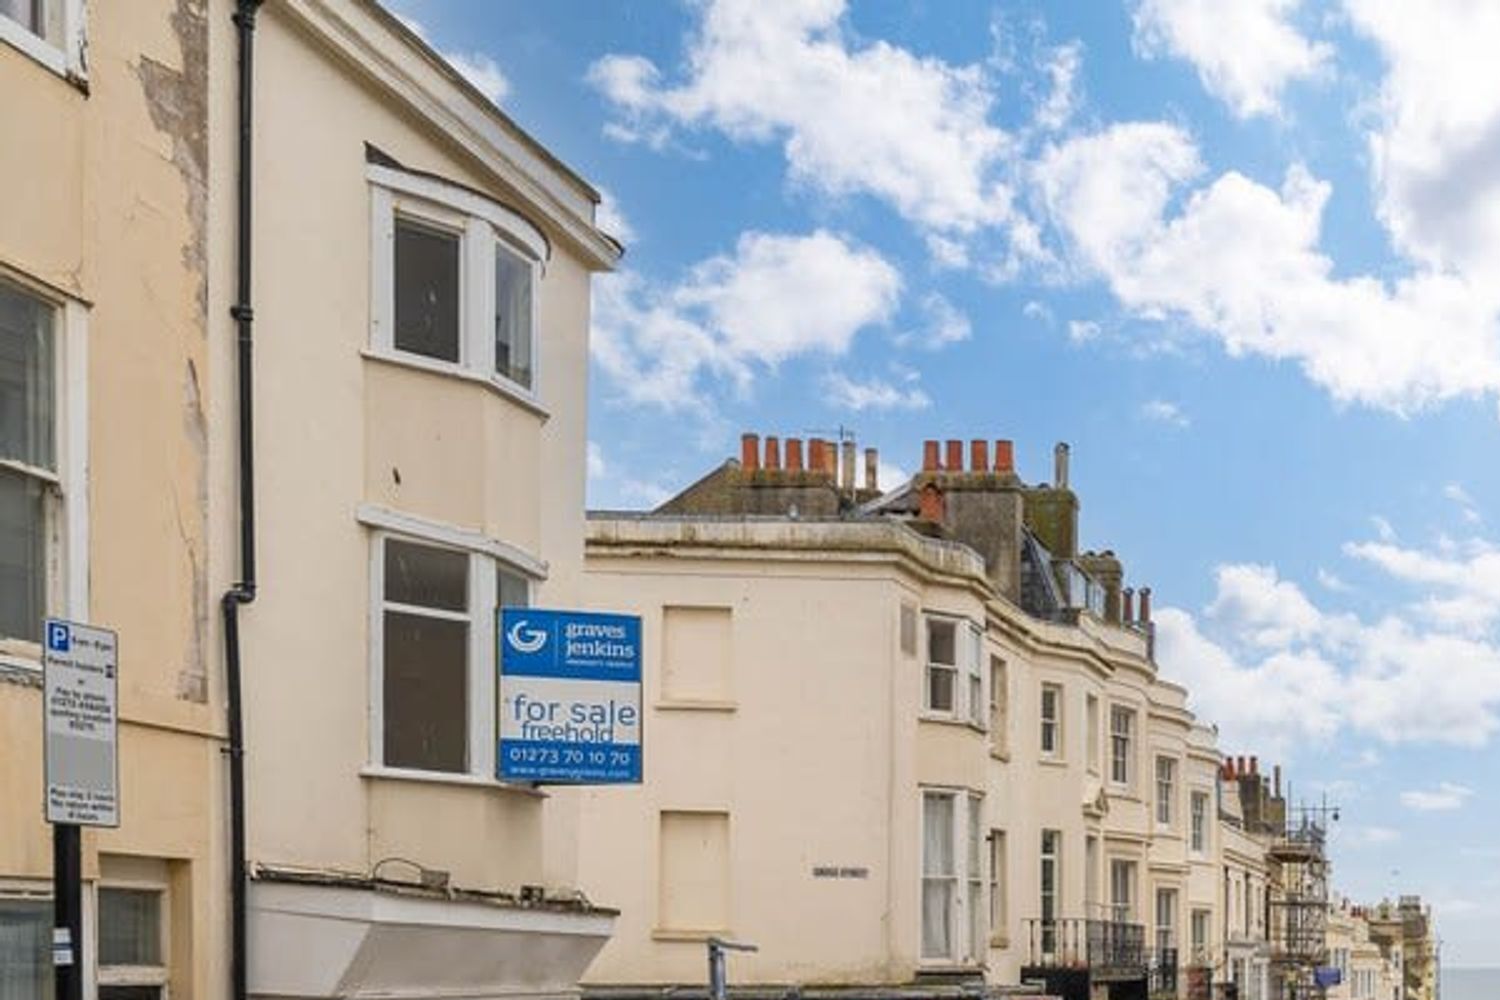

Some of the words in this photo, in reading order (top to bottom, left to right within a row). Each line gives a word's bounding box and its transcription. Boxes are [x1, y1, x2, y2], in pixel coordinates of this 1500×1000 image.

[565, 622, 625, 639] graves
[565, 640, 635, 658] jenkins
[514, 693, 560, 721] for
[570, 700, 637, 726] sale
[521, 720, 614, 742] freehold
[510, 747, 559, 764] 01273
[562, 750, 584, 765] 70
[588, 752, 606, 765] 10
[610, 752, 630, 767] 70
